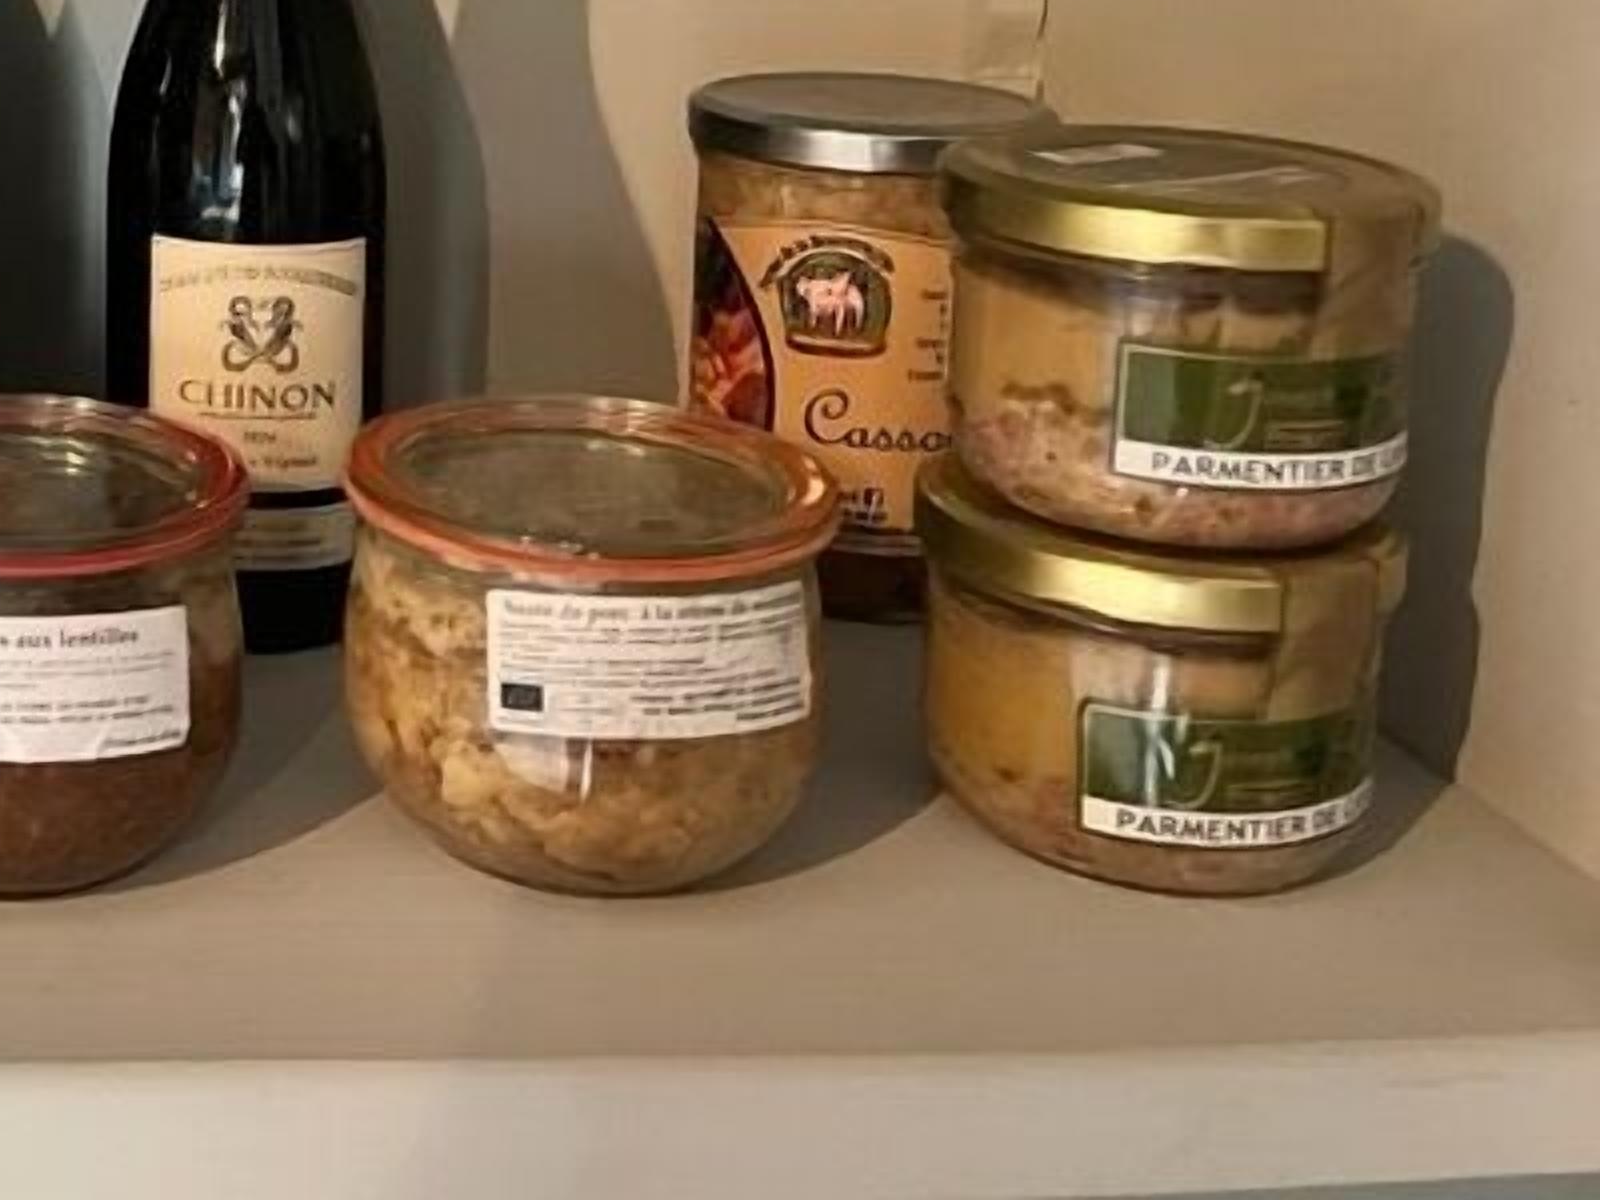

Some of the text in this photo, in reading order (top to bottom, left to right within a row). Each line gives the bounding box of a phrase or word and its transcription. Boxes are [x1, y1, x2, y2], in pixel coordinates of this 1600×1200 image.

[179, 378, 338, 412] CHINON
[804, 388, 953, 455] Casso
[1150, 450, 1346, 482] PARMENTIER
[1115, 807, 1307, 843] PARMENTIER
